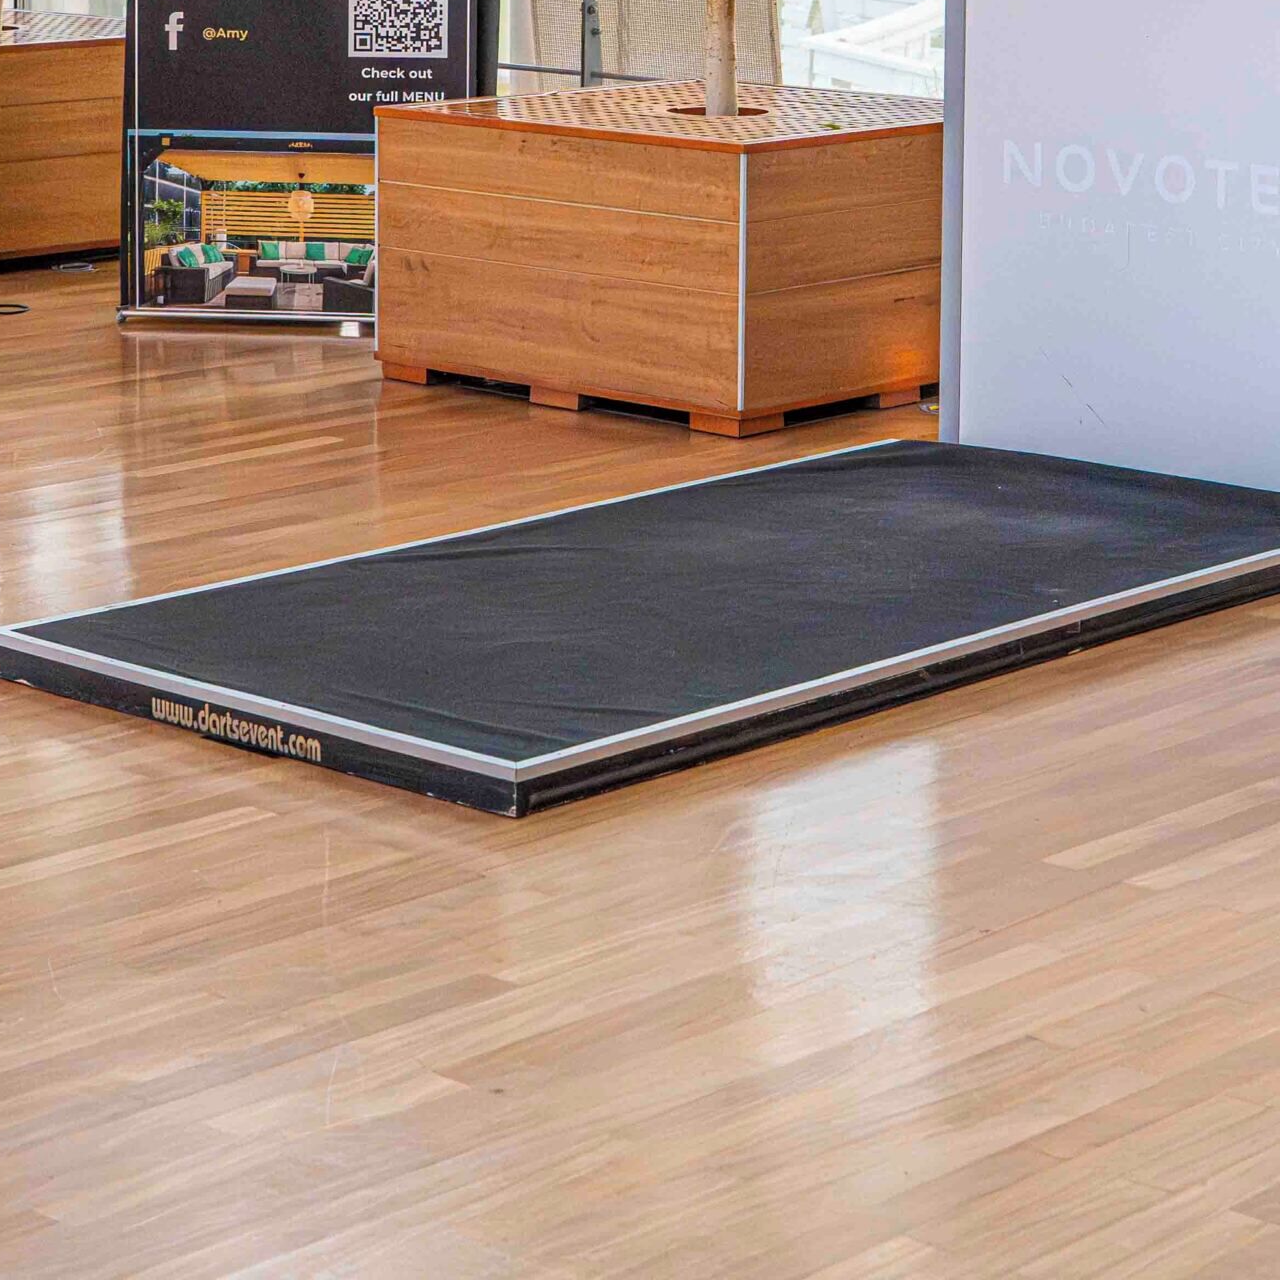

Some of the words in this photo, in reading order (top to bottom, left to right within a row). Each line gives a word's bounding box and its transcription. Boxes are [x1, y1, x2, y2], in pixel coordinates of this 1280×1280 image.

[202, 26, 249, 41] @Amy
[361, 67, 406, 79] Check
[408, 68, 433, 79] out
[348, 91, 372, 101] our
[375, 90, 398, 102] full
[402, 91, 445, 103] MENU
[152, 696, 321, 763] www.dartsevent.com
